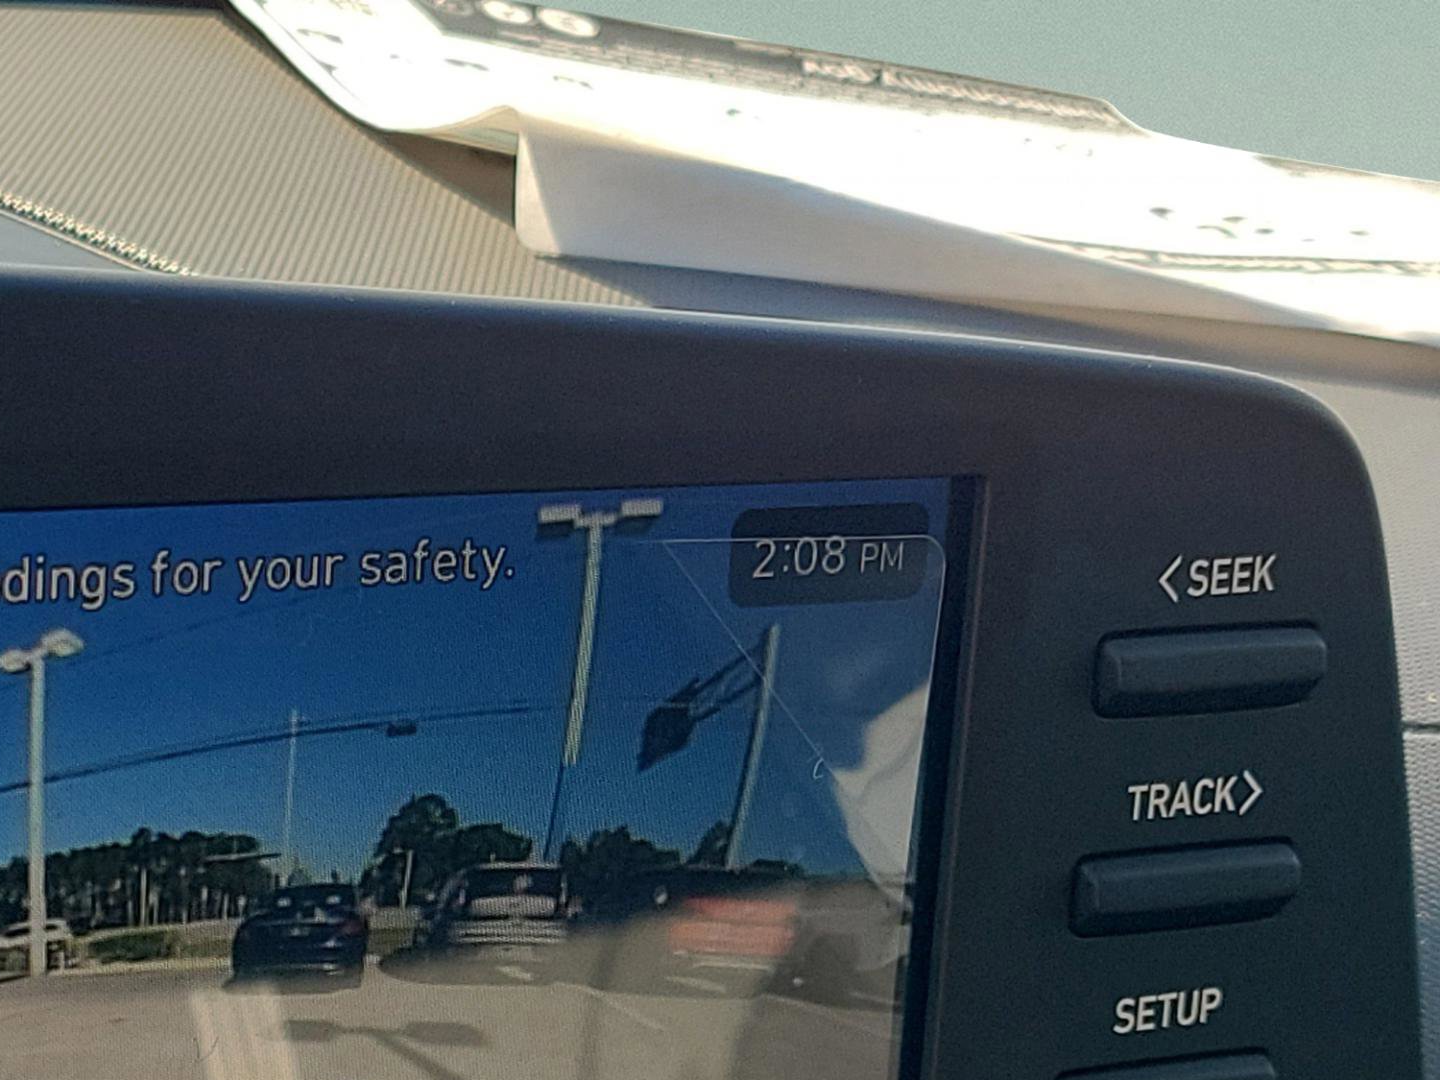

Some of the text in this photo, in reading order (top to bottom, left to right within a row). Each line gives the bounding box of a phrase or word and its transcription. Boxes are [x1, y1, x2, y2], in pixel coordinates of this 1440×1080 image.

[151, 549, 223, 595] for
[237, 552, 344, 602] your
[359, 538, 514, 589] safety.
[752, 535, 905, 579] 2:08 PM
[1186, 554, 1277, 597] SEEK
[1127, 776, 1238, 821] TRACK
[1113, 987, 1222, 1034] SETUP
